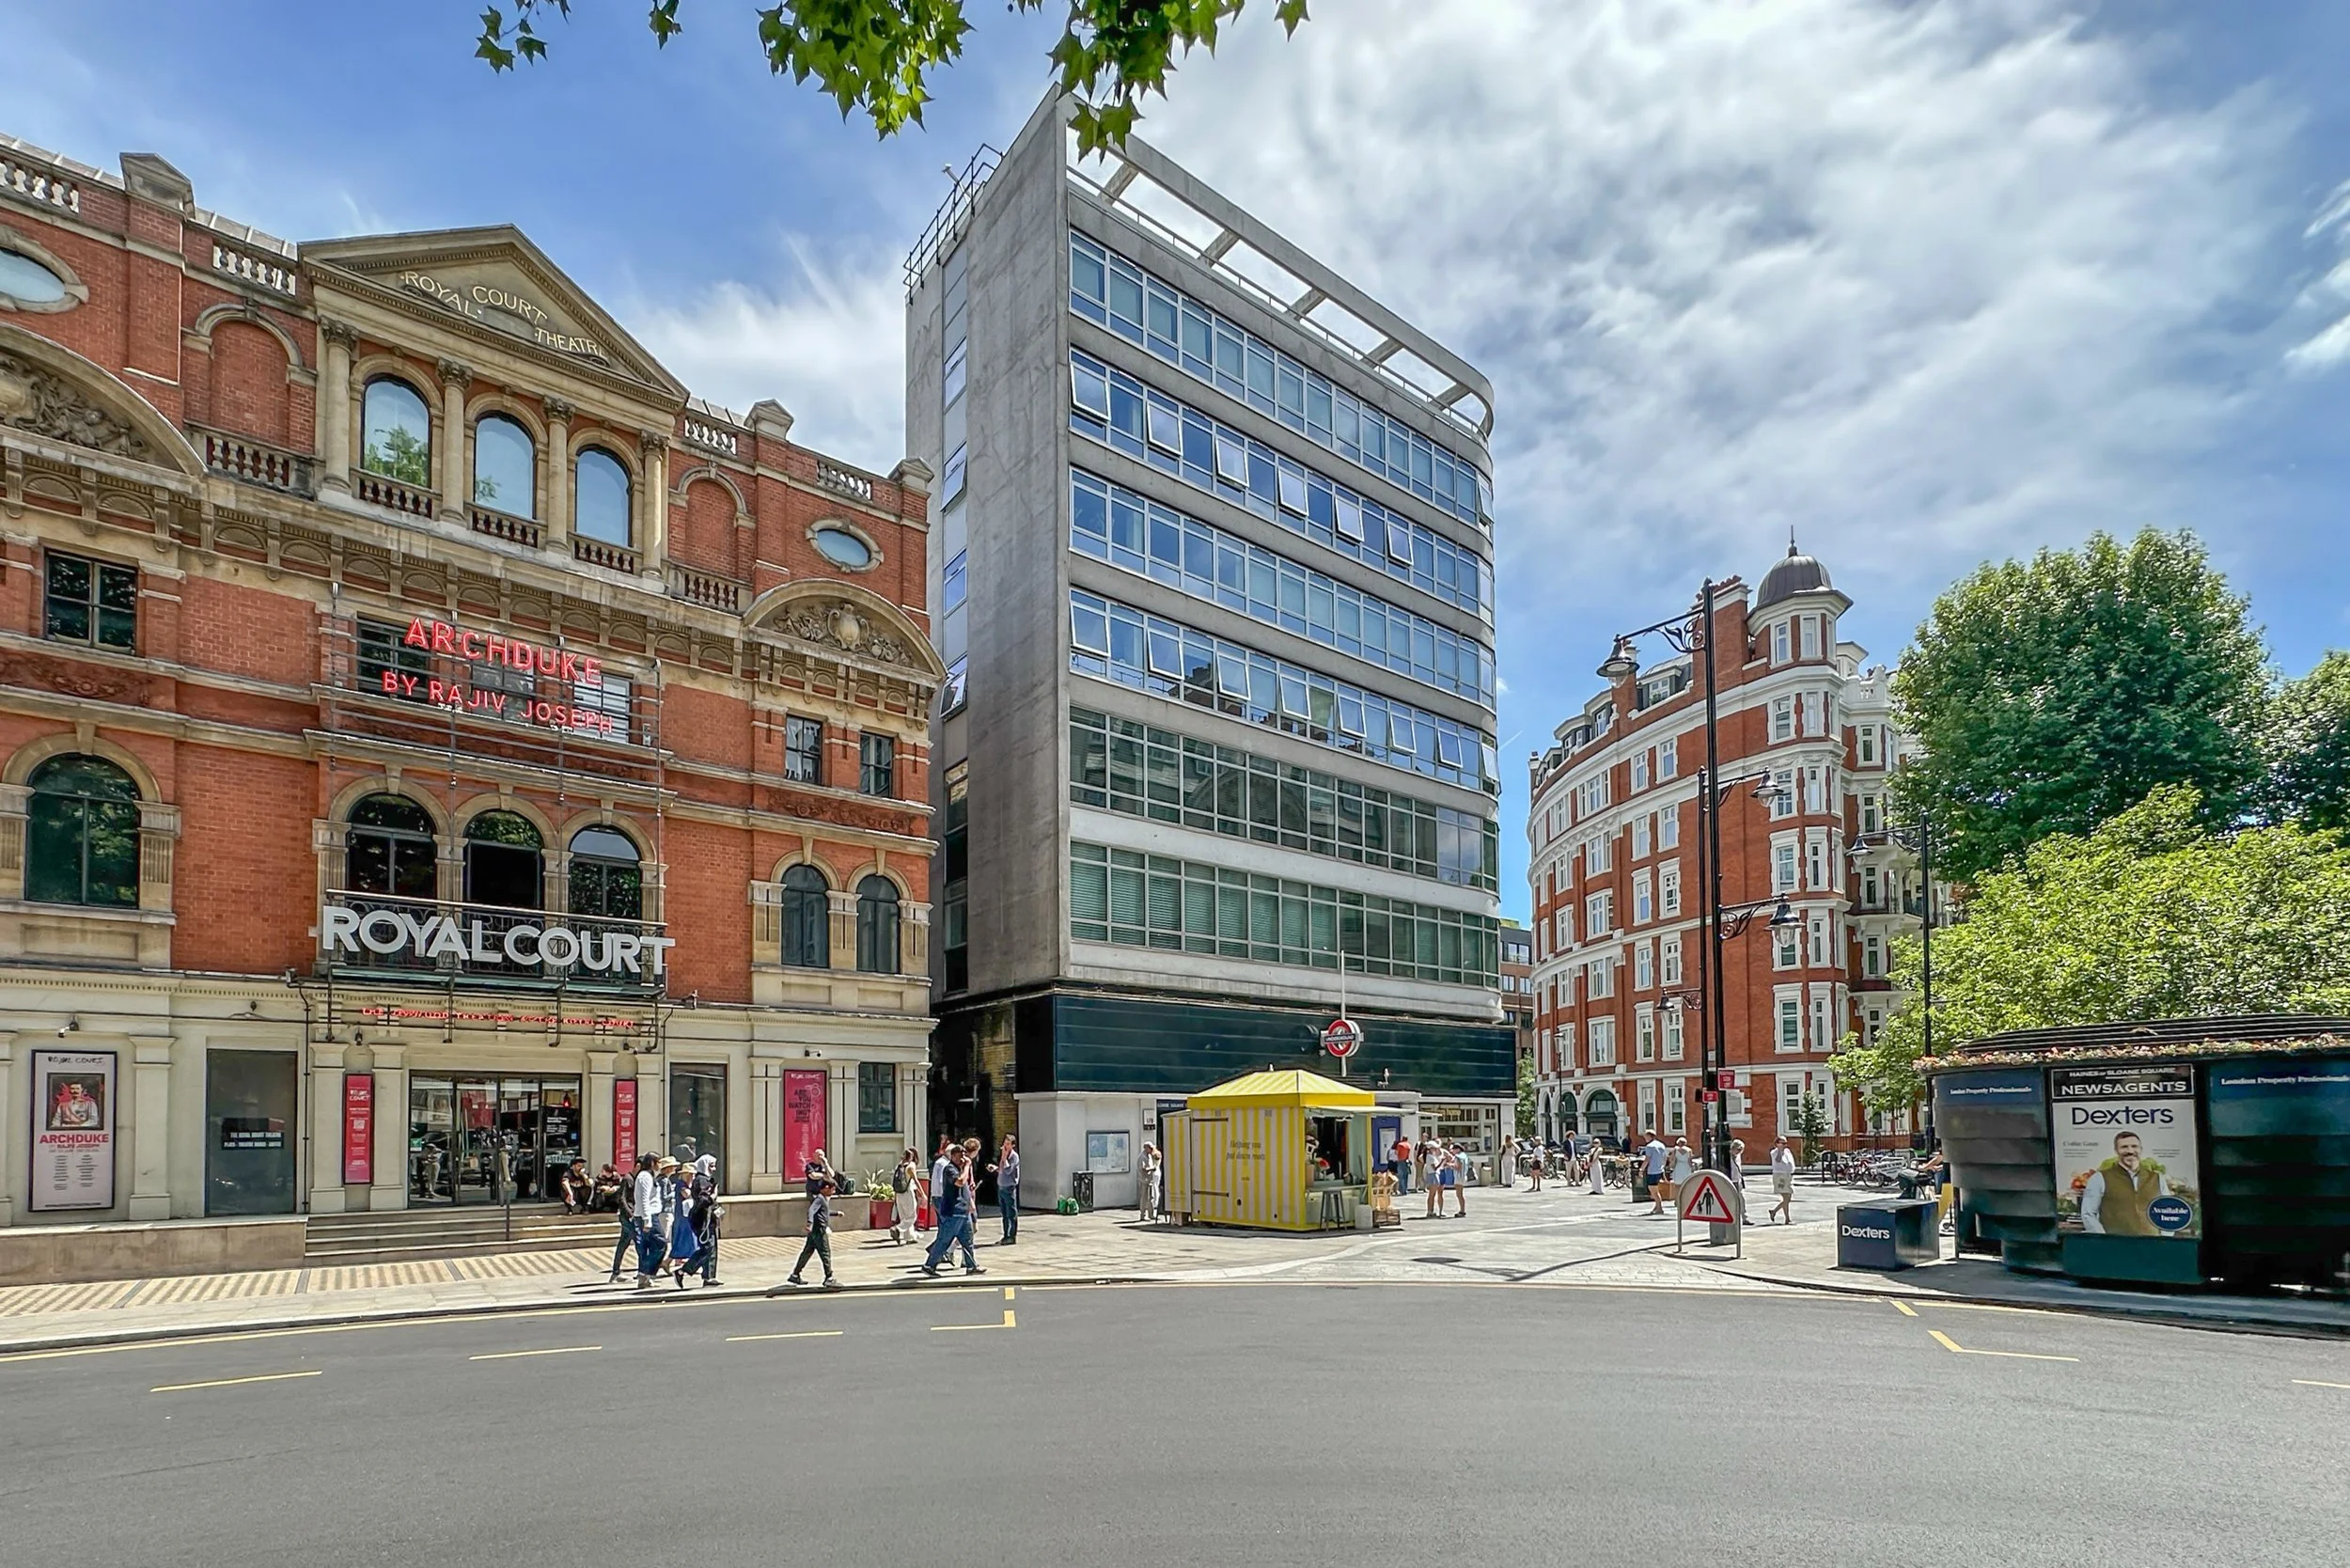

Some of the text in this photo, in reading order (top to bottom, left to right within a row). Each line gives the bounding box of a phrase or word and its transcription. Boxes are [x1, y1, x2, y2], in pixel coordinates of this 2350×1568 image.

[472, 286, 548, 325] COURT
[404, 617, 602, 684] ARCHDUKE
[382, 670, 613, 733] BY RAJIV JOSEPH
[2107, 1068, 2140, 1076] SLOANE
[2060, 1080, 2187, 1095] NEWSAGENTS
[2072, 1105, 2174, 1125] Dexters
[39, 1133, 110, 1144] ARCHDUKE
[2152, 1206, 2188, 1215] Available
[2160, 1214, 2180, 1222] here
[1841, 1225, 1890, 1239] Dexters
